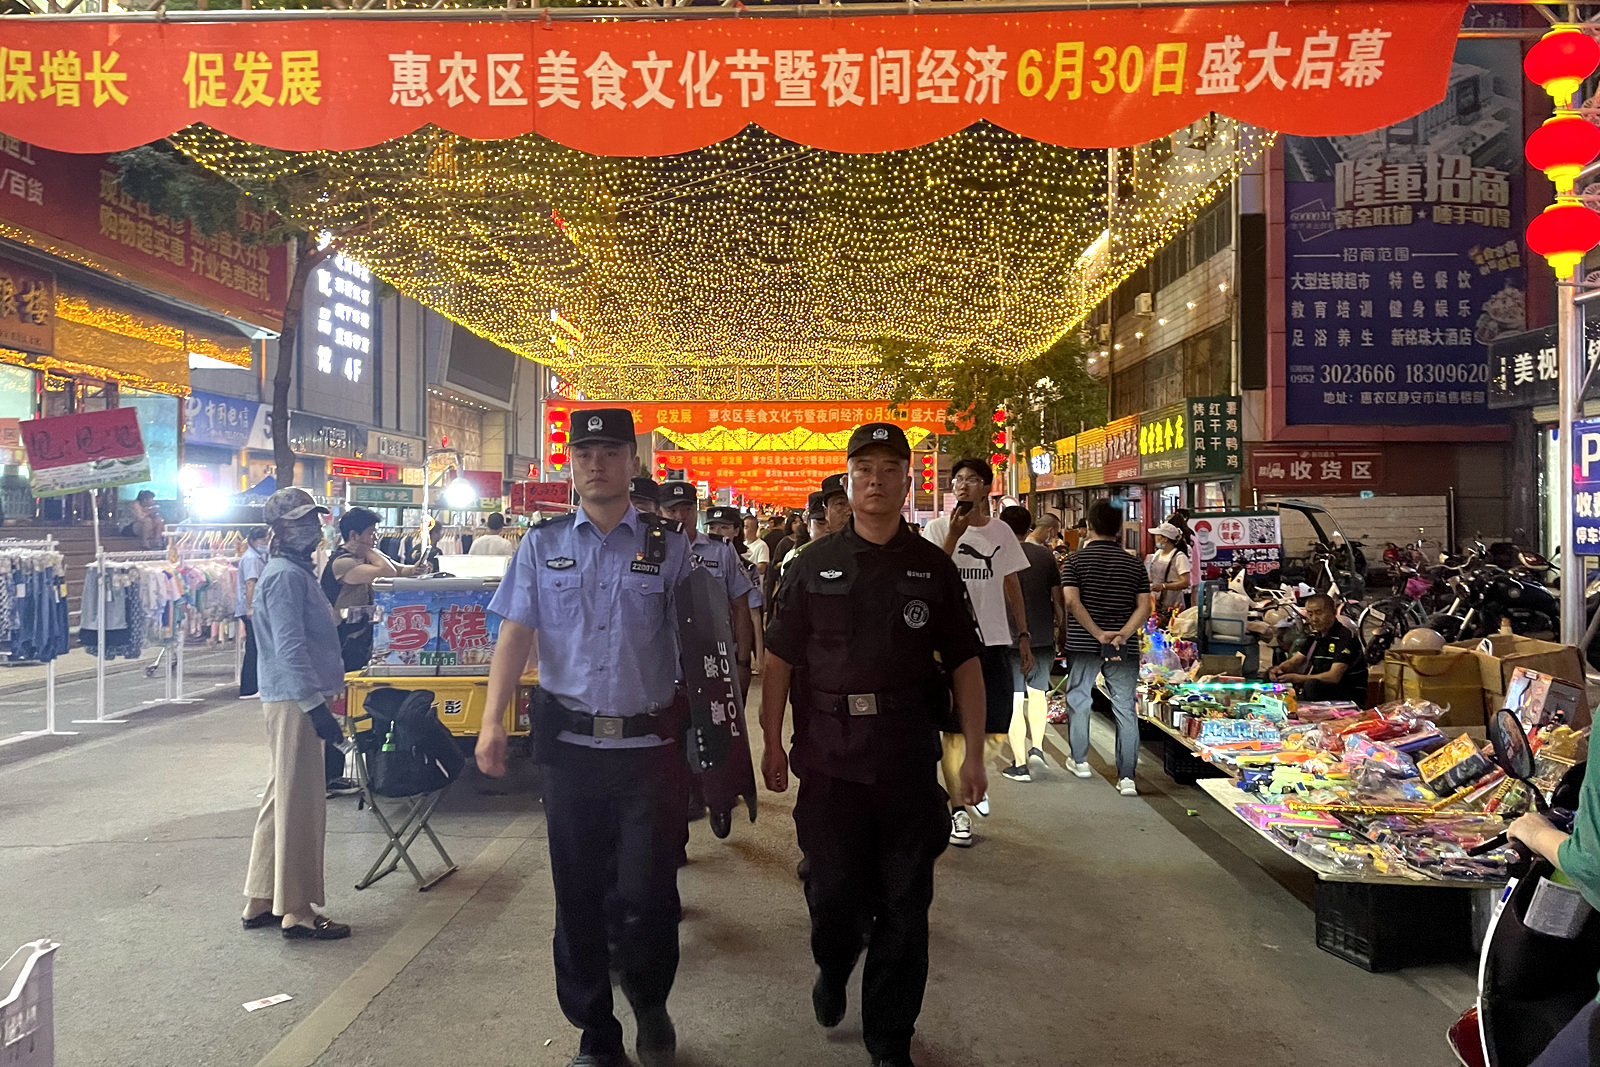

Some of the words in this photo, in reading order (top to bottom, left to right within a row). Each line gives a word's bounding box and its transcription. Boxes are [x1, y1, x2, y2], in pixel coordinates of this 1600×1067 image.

[0, 50, 128, 107] 保增长
[183, 50, 322, 107] 促发展
[1335, 153, 1510, 208] 隆重招商
[1334, 205, 1413, 229] 黄金旺铺
[1343, 247, 1410, 262] 招商范围
[1291, 272, 1370, 290] 大型连锁超市
[1389, 271, 1472, 289] 特色餐饮
[1291, 300, 1373, 319] 教育培训
[1389, 299, 1472, 319] 健身娱乐
[1291, 328, 1375, 347] 足浴养生
[1290, 374, 1315, 384] 0952
[1320, 363, 1396, 384] 3023666
[1405, 362, 1489, 383] 18309620
[205, 400, 250, 430] 中国电信
[656, 409, 693, 424] 促发展
[1193, 401, 1237, 416] 烤红薯
[1194, 418, 1238, 433] 风干鸡
[1195, 436, 1238, 451] 风干鸭
[691, 455, 714, 465] 保增长
[721, 455, 743, 465] 促发展
[1195, 454, 1239, 469] 炸鸡
[1290, 460, 1372, 480] 收货区
[1576, 526, 1600, 545] 停车
[387, 603, 488, 651] 雪糕
[421, 657, 455, 666] 4105
[717, 641, 740, 736] POLICE
